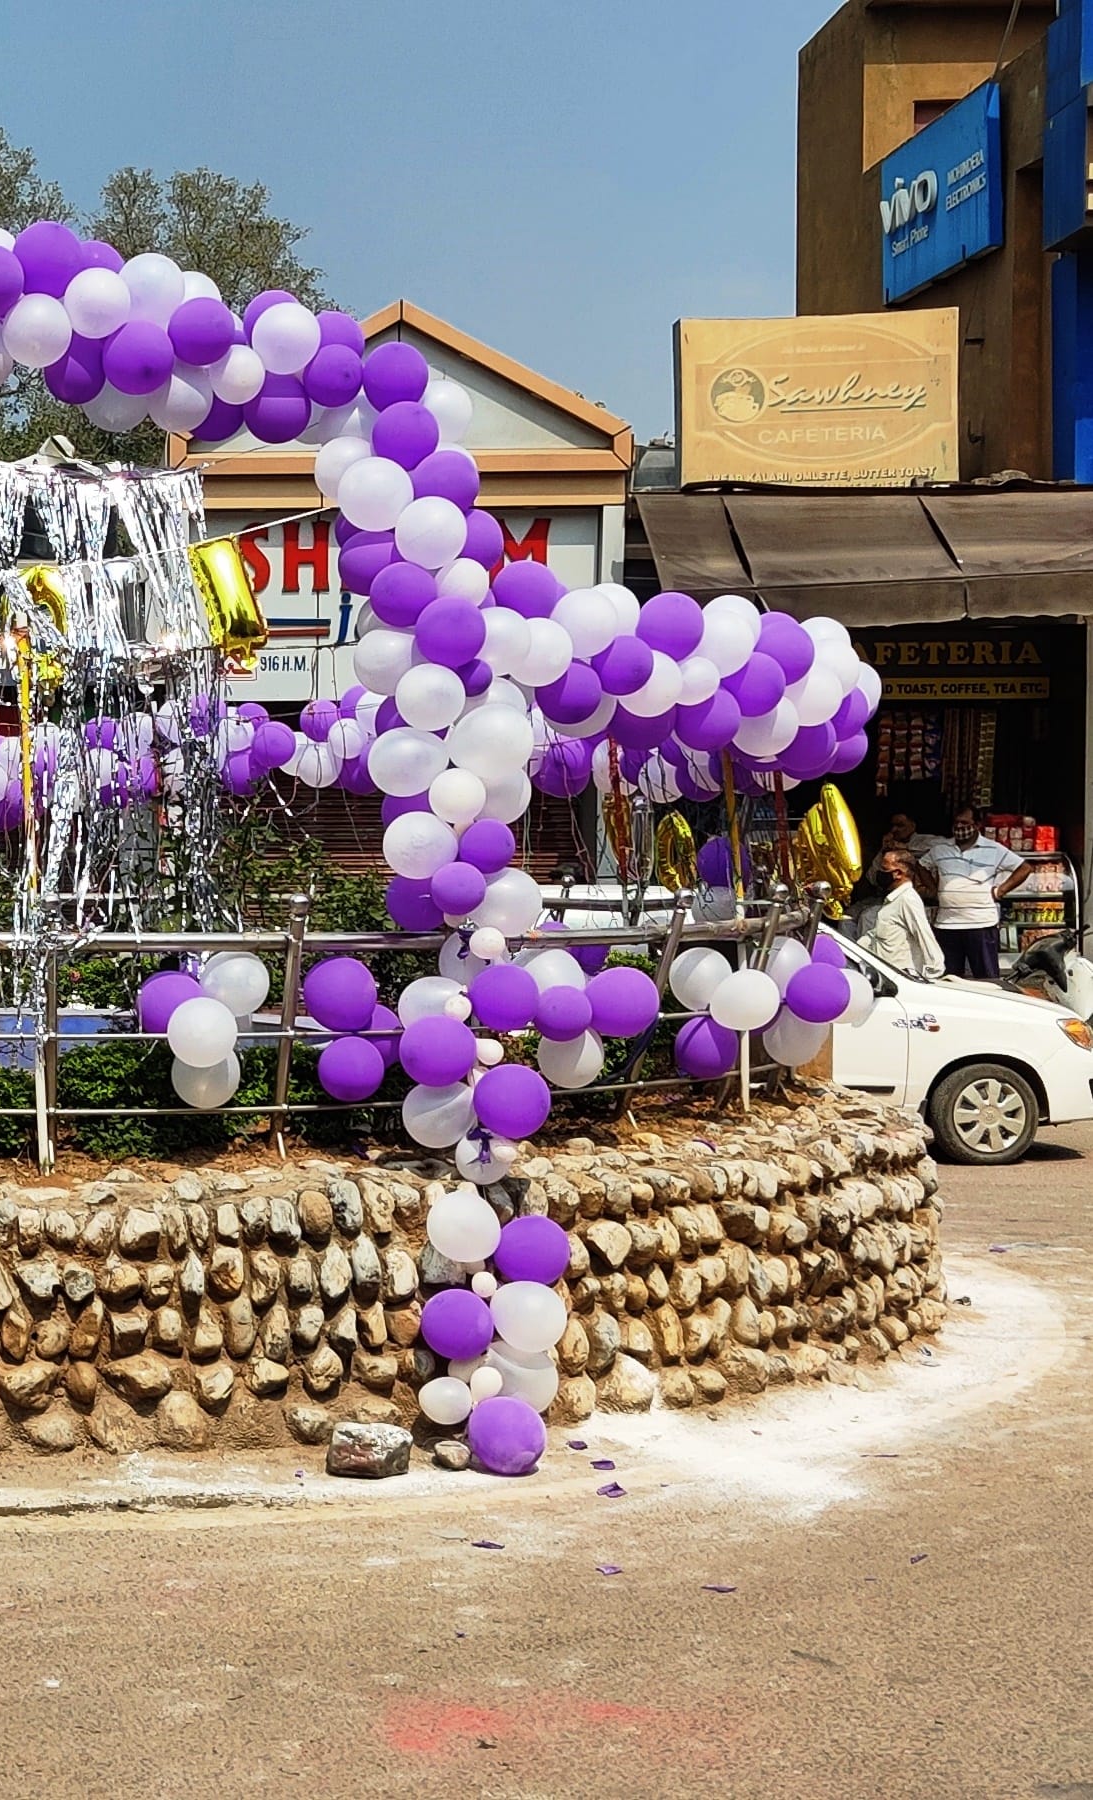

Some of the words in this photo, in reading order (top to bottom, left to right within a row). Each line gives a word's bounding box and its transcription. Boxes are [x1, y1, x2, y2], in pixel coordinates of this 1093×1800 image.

[946, 172, 986, 212] ELECTRONICS
[910, 225, 929, 246] Phone
[768, 371, 927, 412] Sawhney
[758, 426, 887, 445] CAFETERIA
[899, 466, 937, 478] TOAST
[260, 656, 280, 672] 916
[897, 683, 938, 696] TOAST,
[941, 683, 990, 695] COFFEE,
[994, 683, 1017, 694] TEA
[1020, 683, 1047, 694] ETC.
